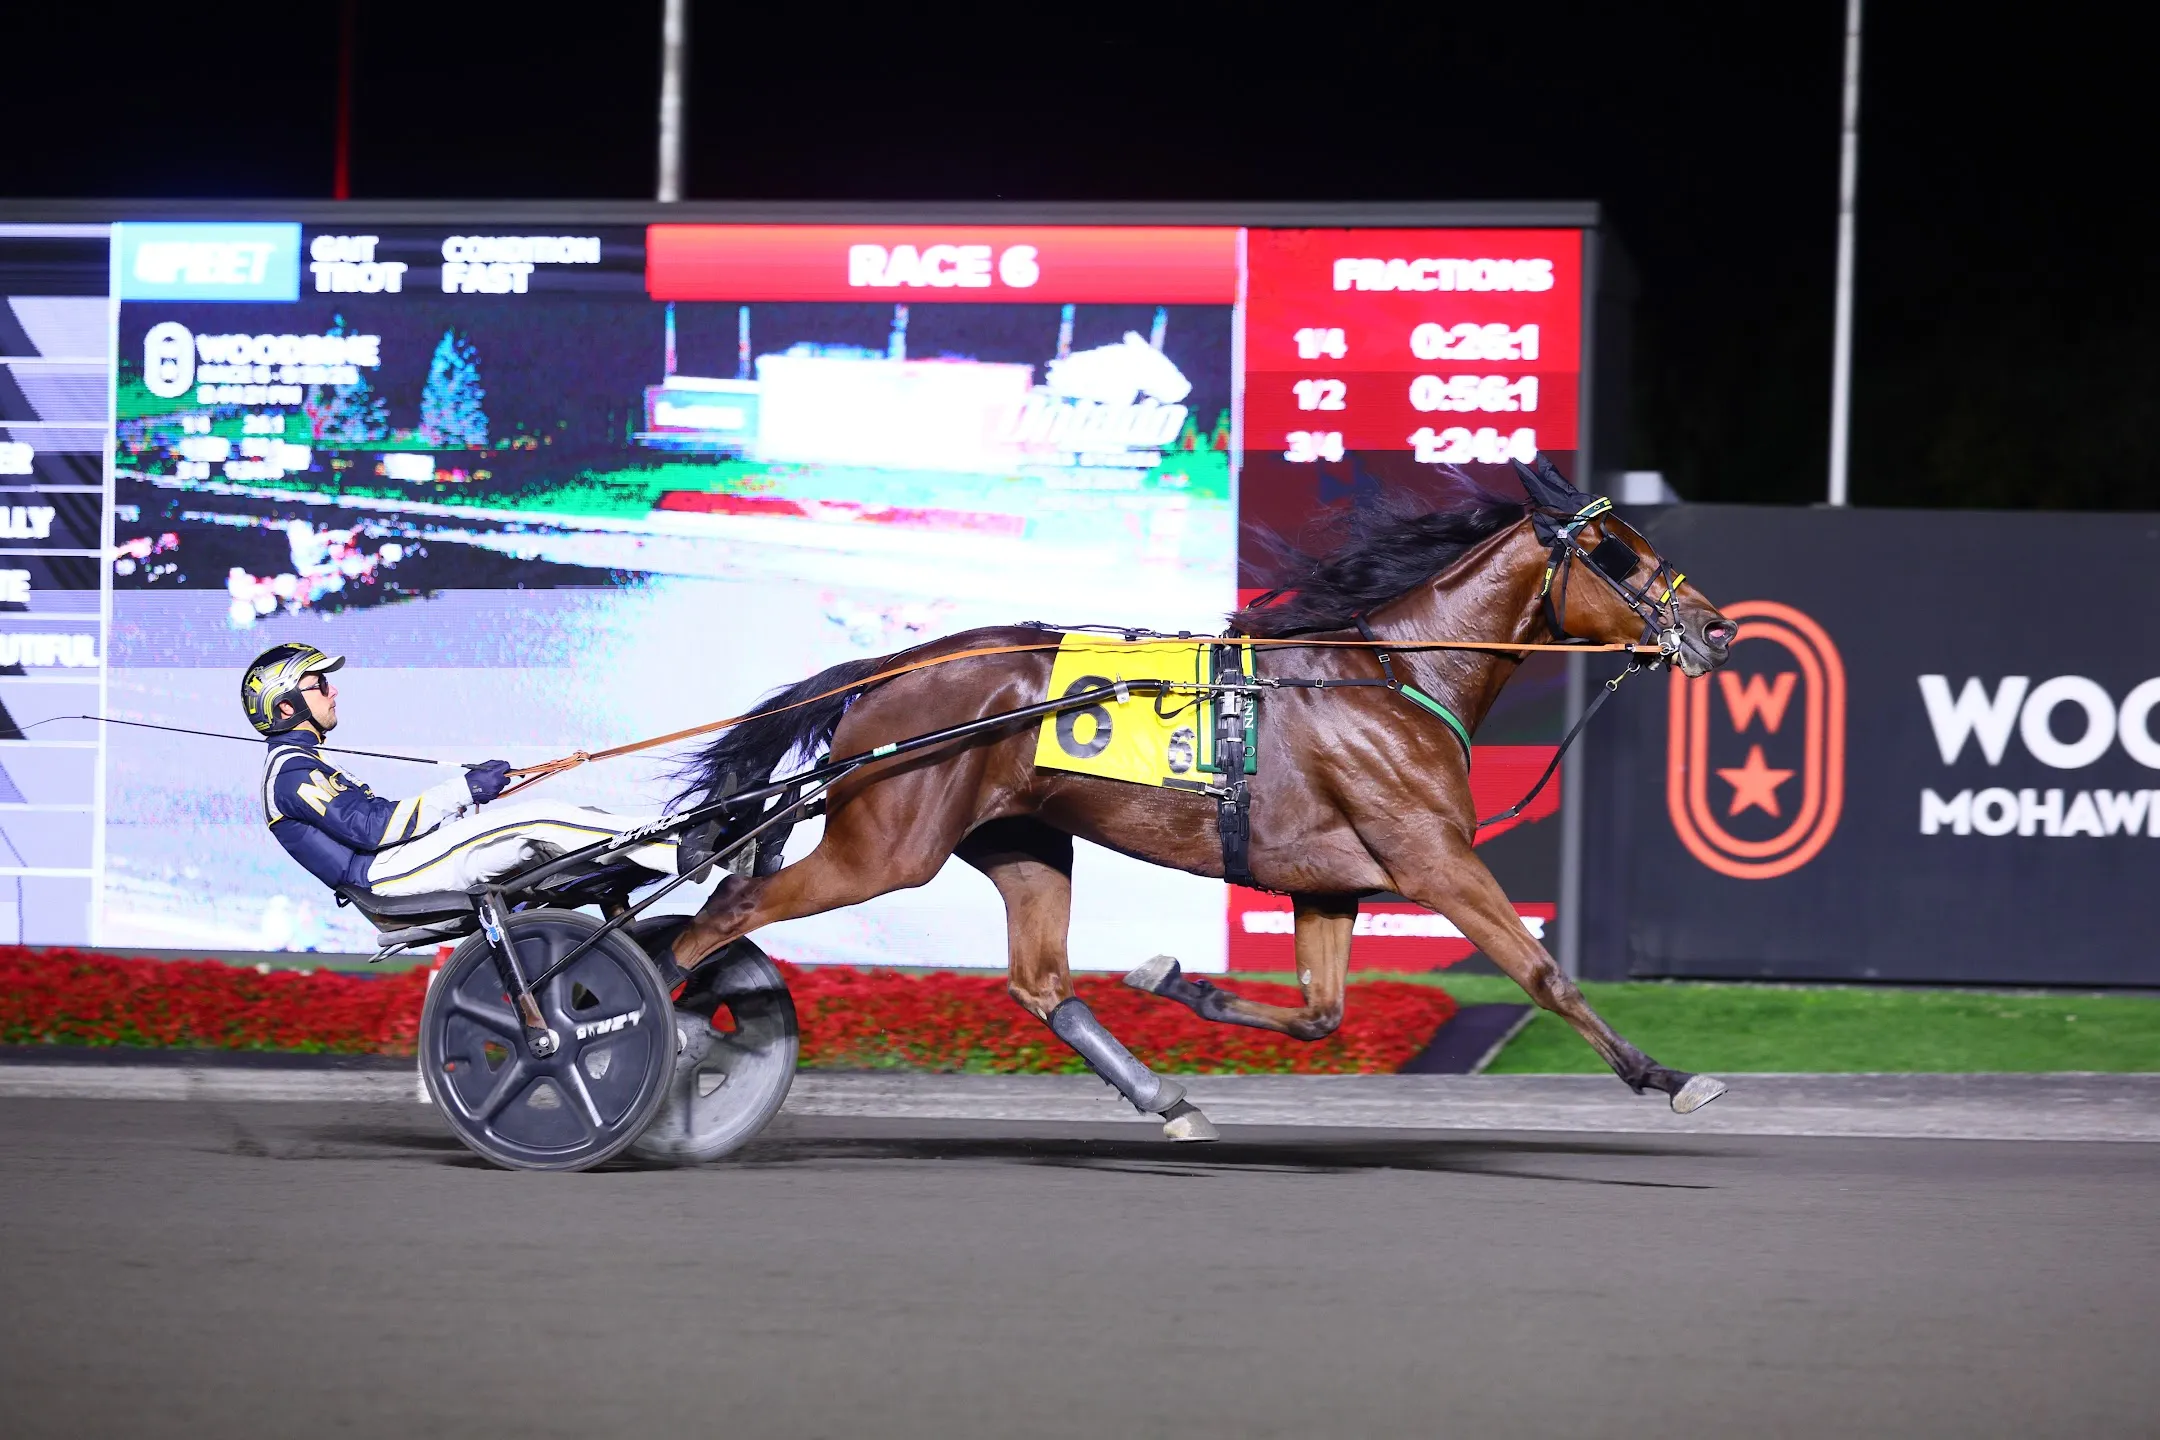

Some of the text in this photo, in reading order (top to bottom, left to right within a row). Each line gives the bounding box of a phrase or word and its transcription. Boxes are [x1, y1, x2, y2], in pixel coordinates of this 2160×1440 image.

[441, 236, 601, 263] CONDITION
[848, 244, 1040, 288] RACE 6
[310, 262, 408, 293] TROT
[441, 262, 534, 294] FAST
[1333, 257, 1554, 292] FRACTIONS
[1293, 327, 1348, 360] 1/4
[1292, 375, 1539, 413] 1/2 0:56:1
[1284, 431, 1346, 463] 3/4
[1718, 670, 1798, 734] W
[1167, 727, 1196, 774] 6
